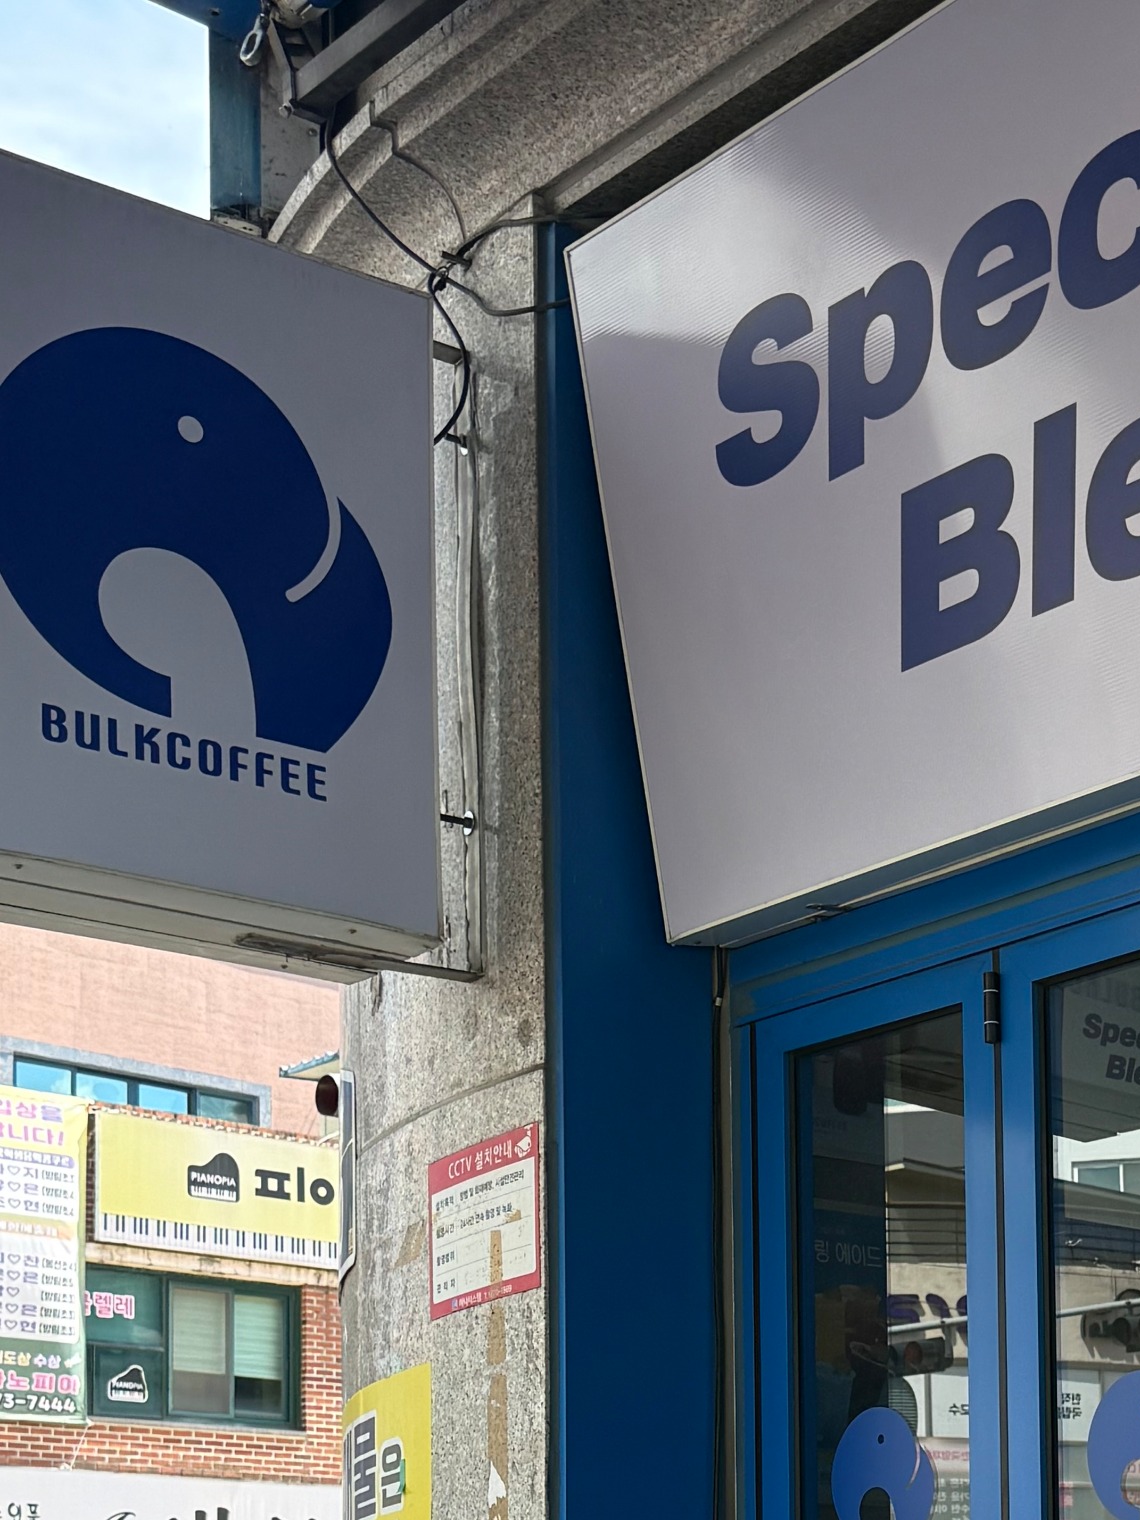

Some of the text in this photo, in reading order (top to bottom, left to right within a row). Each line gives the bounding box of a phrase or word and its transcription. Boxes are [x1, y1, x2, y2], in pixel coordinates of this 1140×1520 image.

[41, 702, 327, 802] BULKCOFFEE
[190, 1171, 237, 1187] PIANOPIA
[449, 1141, 512, 1179] CCTV 설치안내
